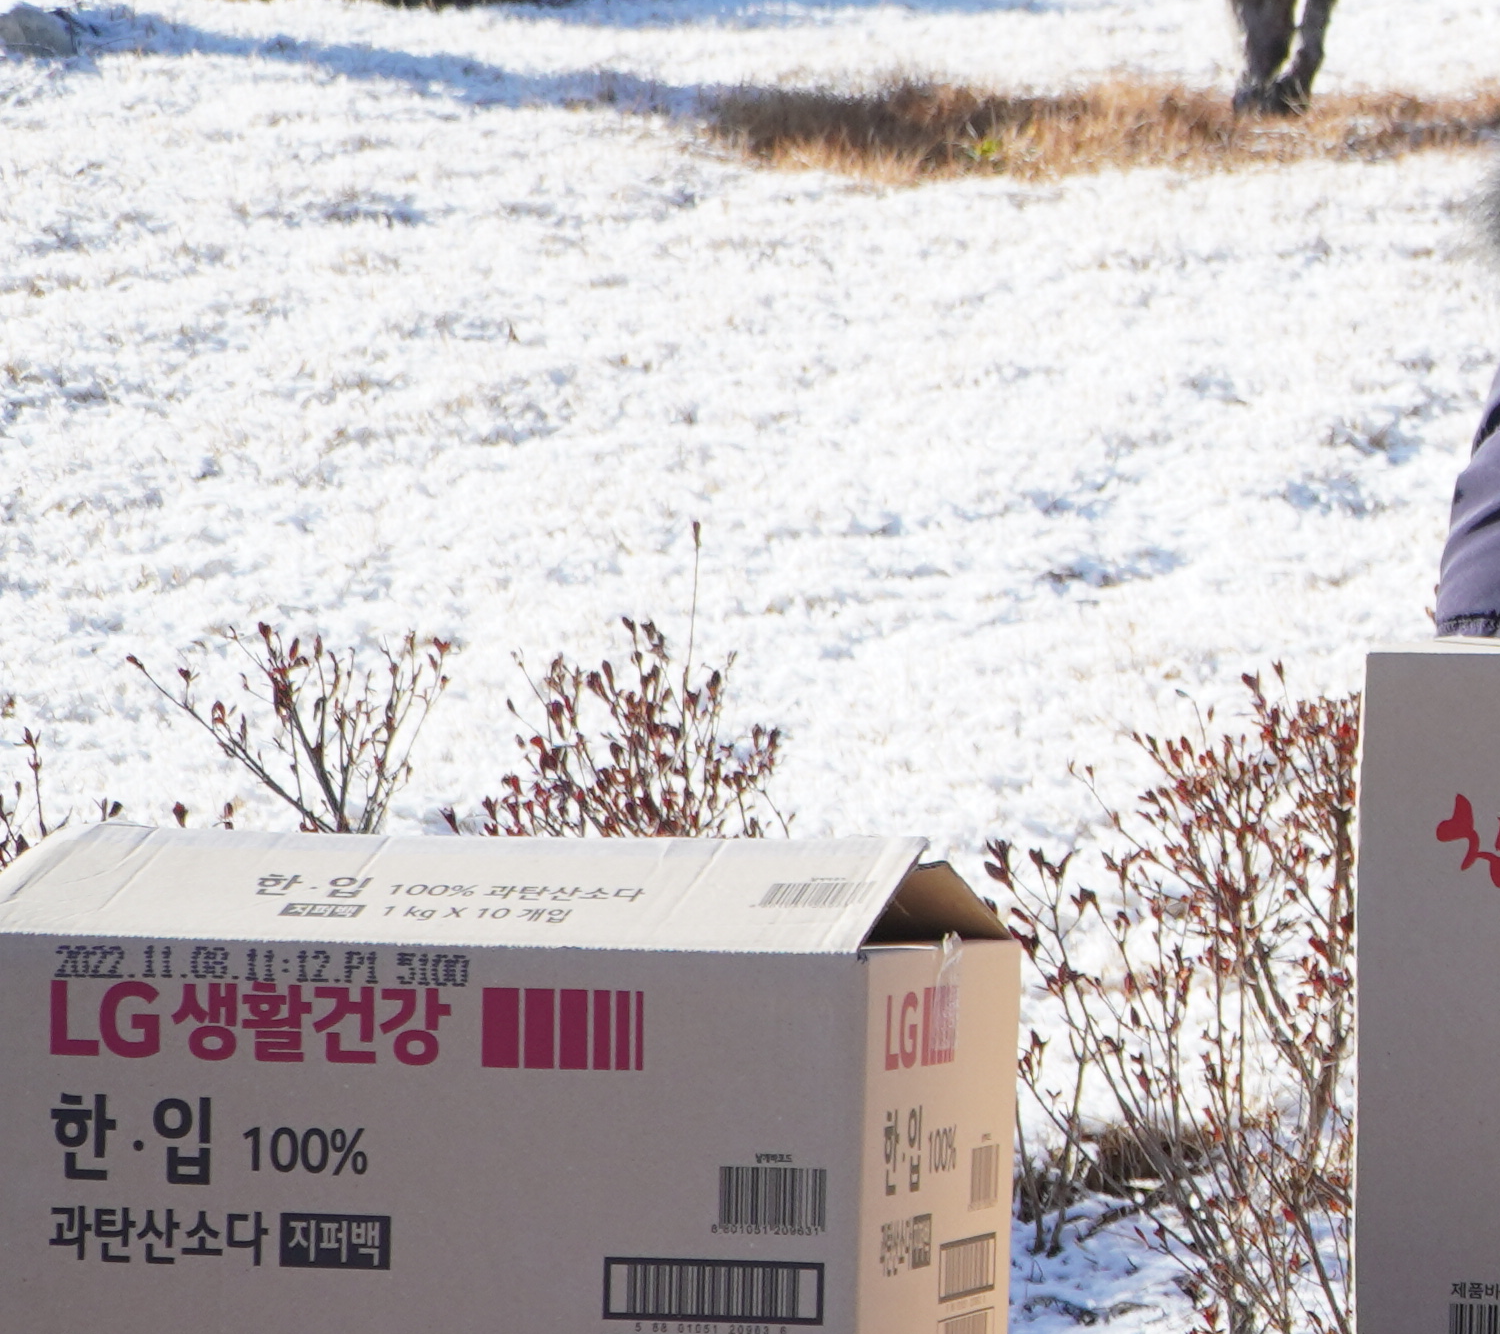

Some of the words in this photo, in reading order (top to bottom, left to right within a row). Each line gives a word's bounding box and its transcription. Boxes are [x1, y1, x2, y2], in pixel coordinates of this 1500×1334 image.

[391, 883, 477, 898] 100%
[484, 886, 645, 901] 과탄산소다
[517, 908, 571, 923] 개입
[243, 1127, 368, 1176] 100%
[48, 1205, 269, 1267] 과탄산소다
[288, 1219, 381, 1266] 지퍼백
